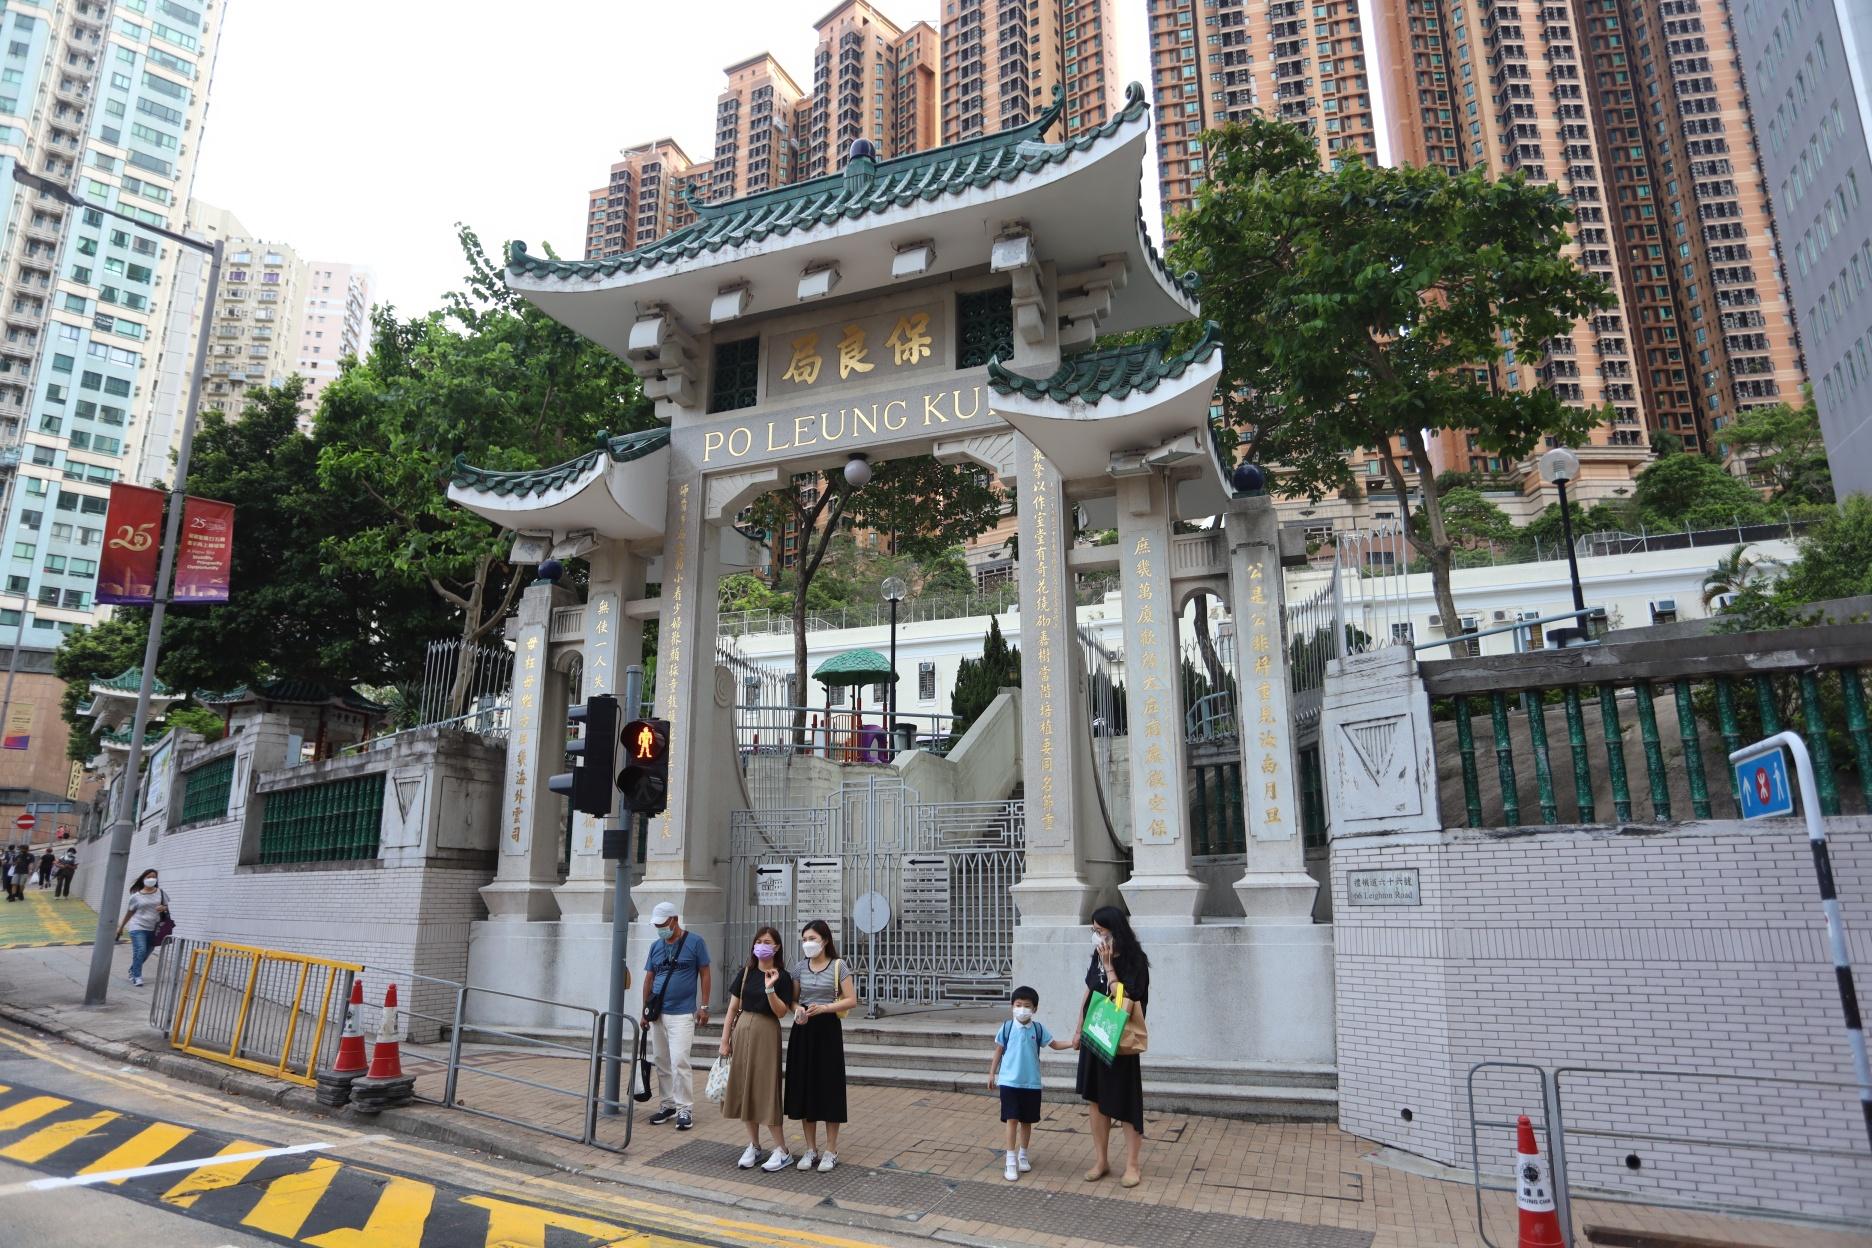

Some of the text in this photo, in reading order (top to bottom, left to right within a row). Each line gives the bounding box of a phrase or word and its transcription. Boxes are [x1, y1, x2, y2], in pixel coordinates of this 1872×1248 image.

[703, 387, 997, 462] PO LEUNG KU
[108, 523, 156, 551] 25
[191, 517, 206, 529] 25
